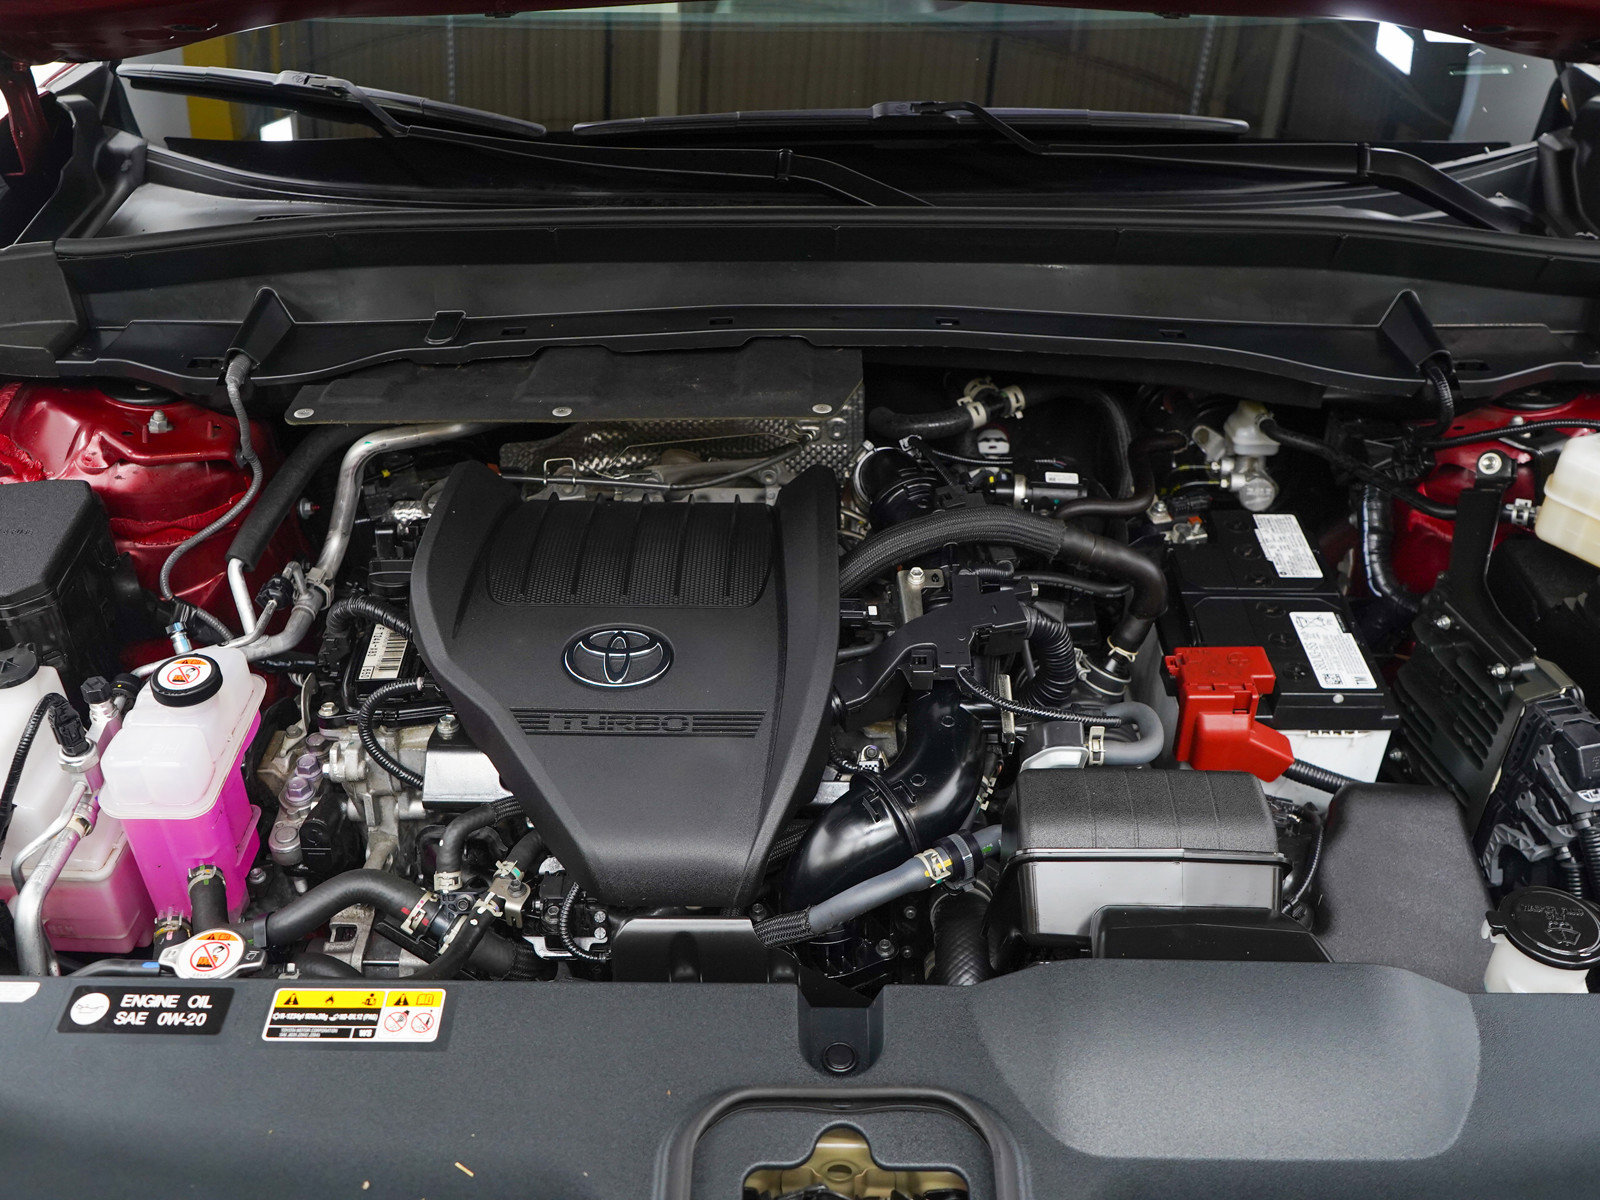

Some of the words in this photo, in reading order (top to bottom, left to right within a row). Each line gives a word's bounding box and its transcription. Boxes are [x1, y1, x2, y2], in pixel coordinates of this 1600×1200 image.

[553, 713, 690, 732] TURBO
[119, 994, 181, 1008] ENGINE
[187, 995, 213, 1009] OIL
[113, 1011, 149, 1026] SAE
[156, 1012, 208, 1027] 0W-20
